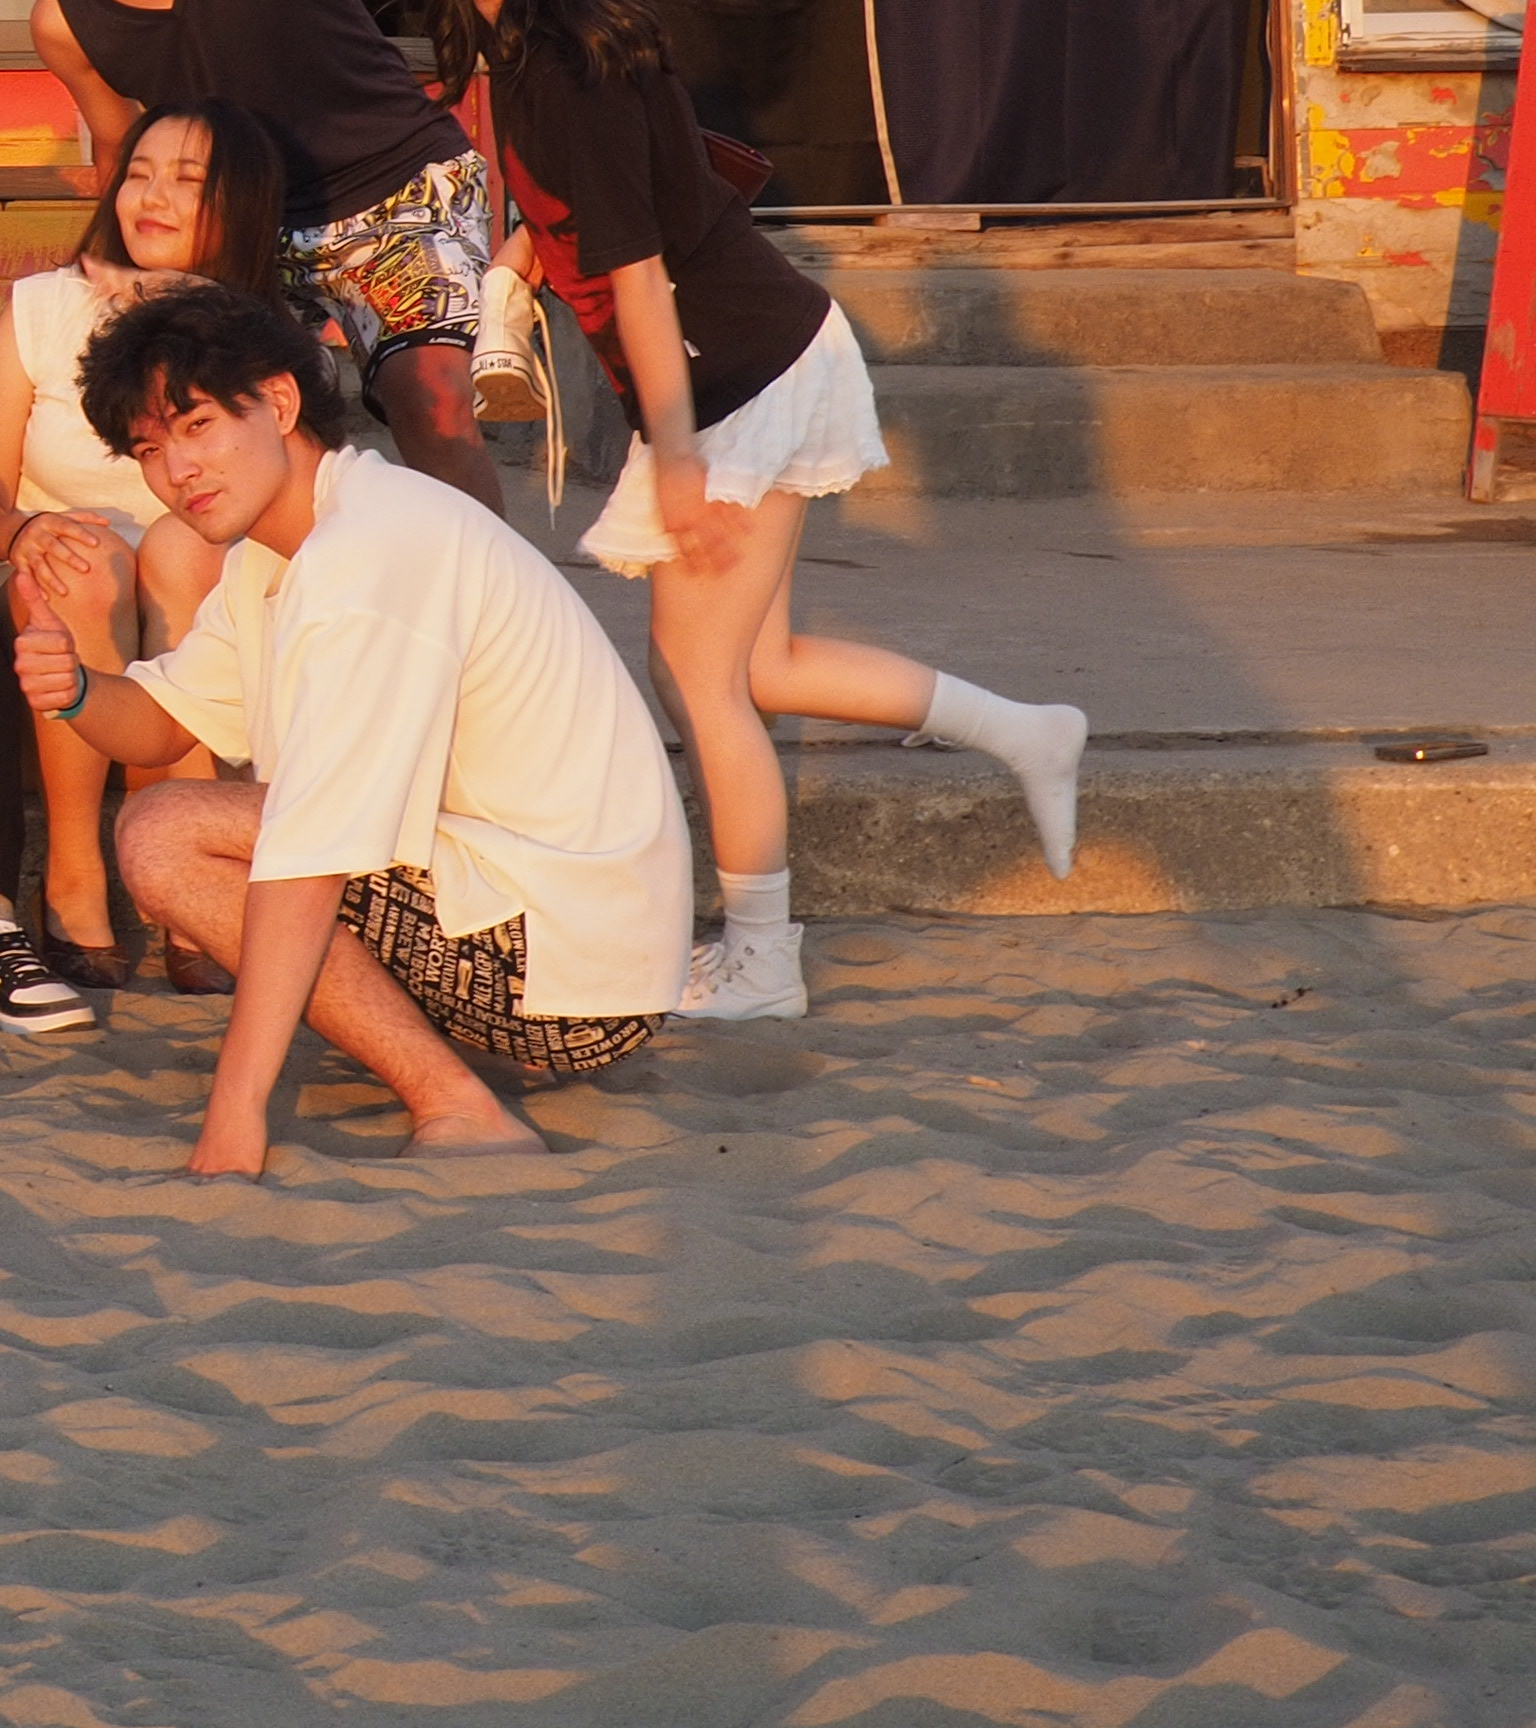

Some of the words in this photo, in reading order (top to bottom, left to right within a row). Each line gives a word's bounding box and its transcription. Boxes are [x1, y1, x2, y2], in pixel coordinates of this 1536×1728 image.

[395, 909, 419, 965] BREW
[569, 1020, 639, 1060] GROWLER
[573, 1052, 613, 1071] MALT
